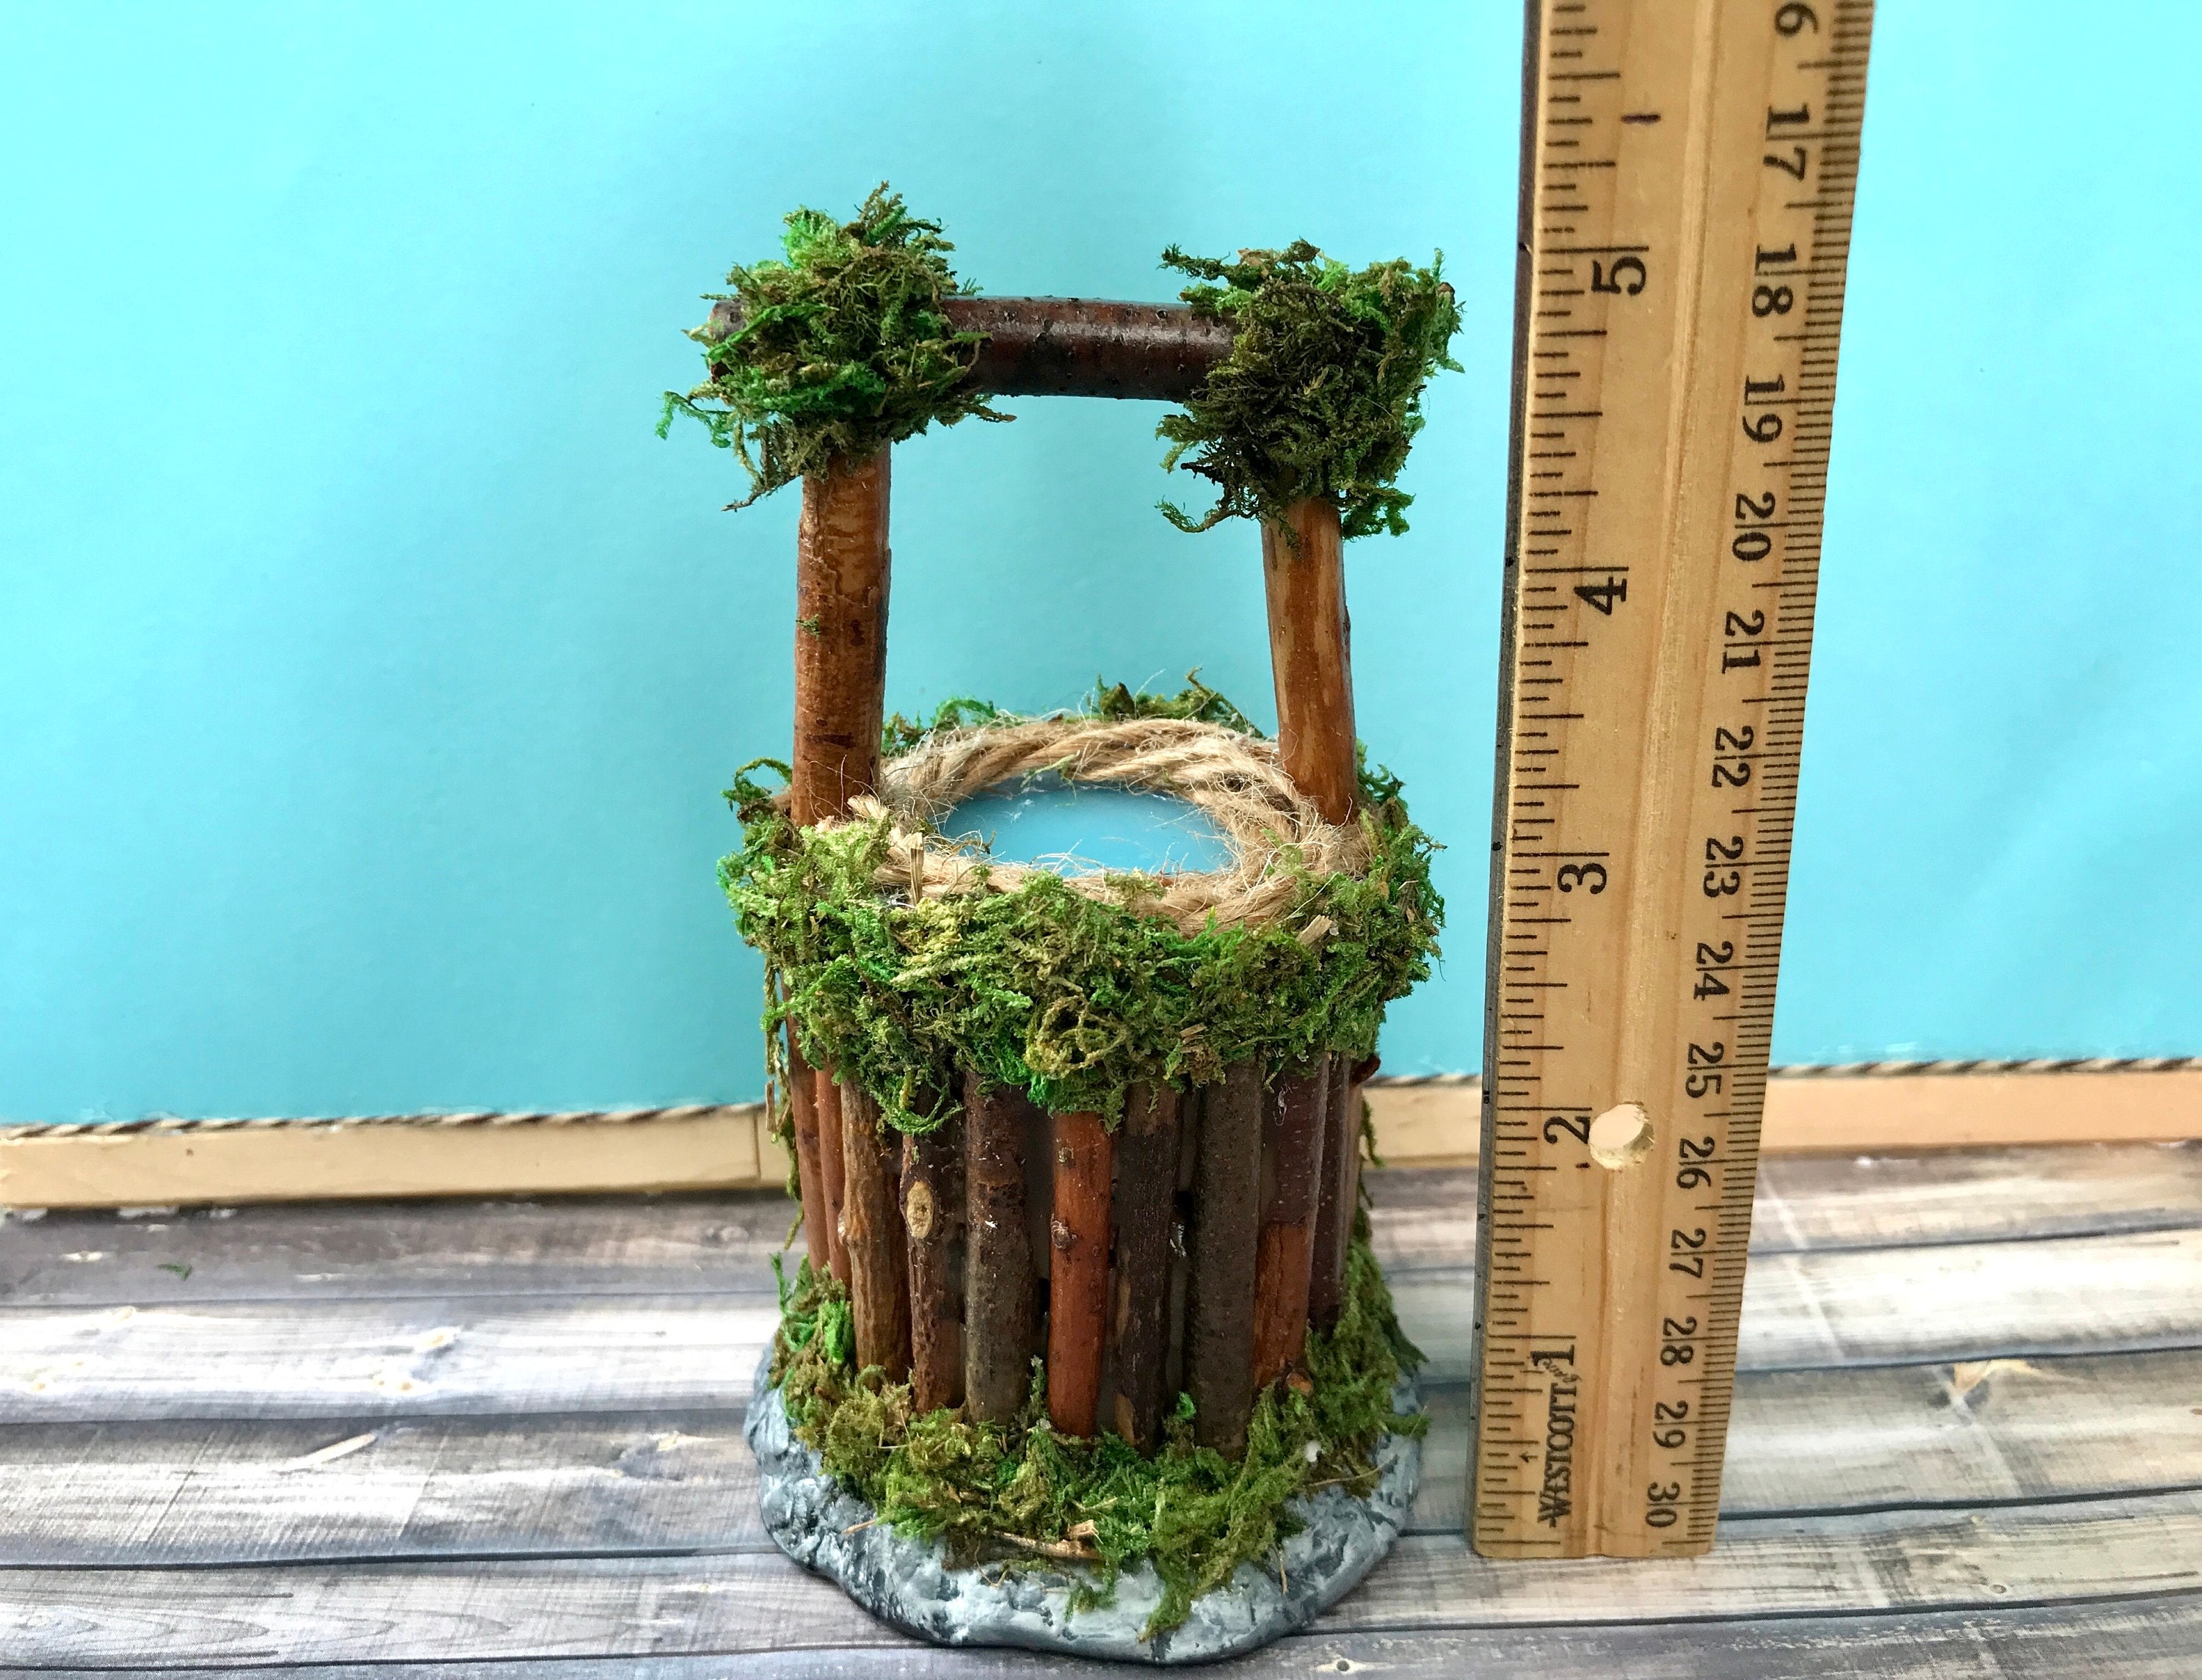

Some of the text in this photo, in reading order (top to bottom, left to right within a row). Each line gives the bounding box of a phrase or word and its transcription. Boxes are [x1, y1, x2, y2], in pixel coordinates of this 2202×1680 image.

[1763, 103, 1810, 181] 17
[1591, 255, 1647, 297] 5
[1752, 243, 1797, 318] 18
[1742, 374, 1785, 443] 19
[1732, 491, 1776, 561] 20
[1574, 576, 1627, 615] 4
[1721, 609, 1765, 674] 21
[1711, 725, 1755, 788] 22
[1557, 862, 1608, 895] 3
[1703, 835, 1745, 898] 23
[1693, 940, 1734, 1000] 24
[1685, 1041, 1725, 1099] 25
[1543, 1115, 1591, 1145] 2
[1676, 1136, 1716, 1190] 26
[1668, 1227, 1707, 1279] 27
[1530, 1343, 1575, 1368] 1
[1660, 1315, 1698, 1367] 28
[1652, 1400, 1689, 1450] 29
[1537, 1382, 1577, 1528] WESTCOTT
[1644, 1481, 1681, 1528] 30
